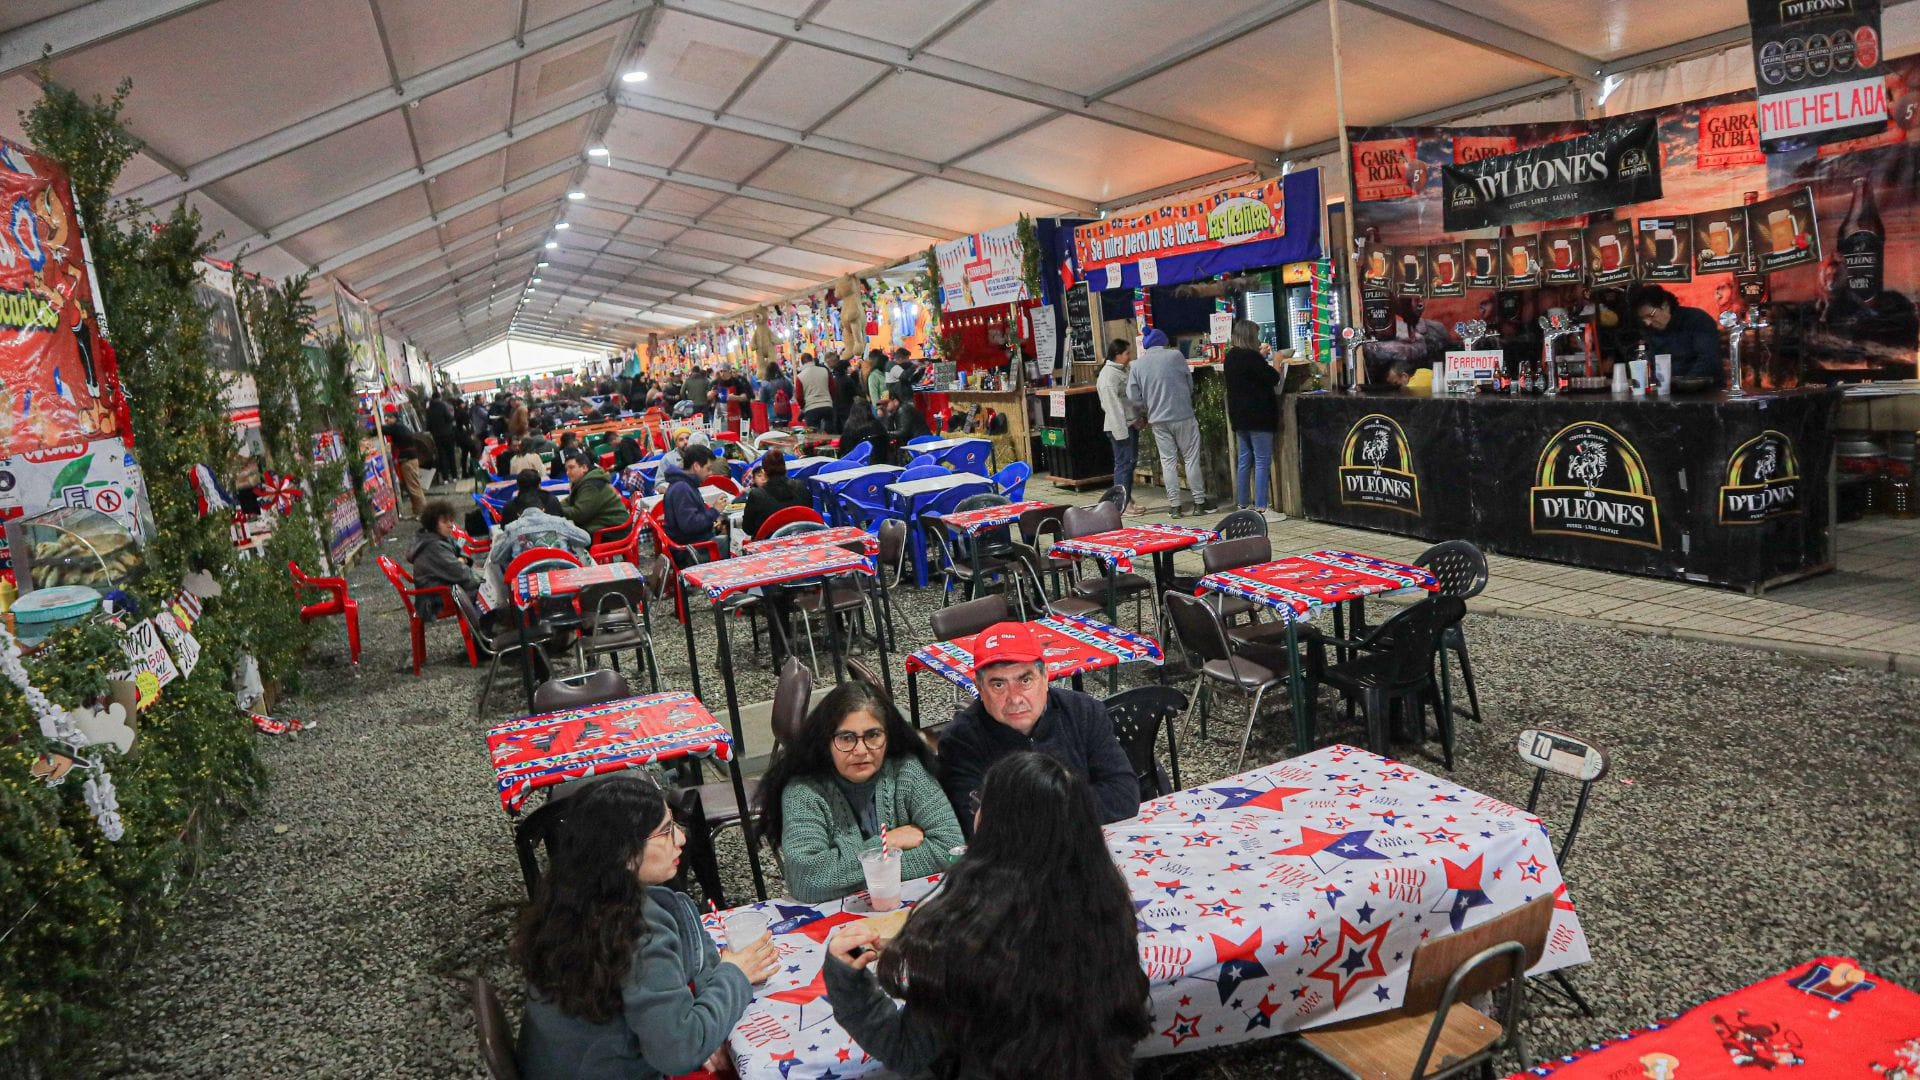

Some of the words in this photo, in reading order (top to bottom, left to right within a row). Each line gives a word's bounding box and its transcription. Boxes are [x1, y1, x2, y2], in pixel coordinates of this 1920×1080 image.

[1761, 84, 1887, 133] MICHELADA
[1707, 114, 1758, 133] GARRA
[1711, 131, 1756, 149] RUBIA
[1361, 149, 1408, 167] GARRA
[1368, 165, 1403, 182] ROJA
[1475, 151, 1609, 202] D'LEONES
[1090, 239, 1103, 261] Se
[1104, 234, 1124, 259] mira
[1124, 232, 1147, 258] pero
[1148, 230, 1160, 251] no
[1162, 228, 1174, 247] se
[1345, 475, 1411, 500] D'LEONES
[1541, 498, 1645, 527] D'LEONES
[147, 648, 165, 668] 500
[501, 771, 546, 788] Chile
[564, 759, 609, 770] Chile
[1388, 881, 1422, 904] VIVA
